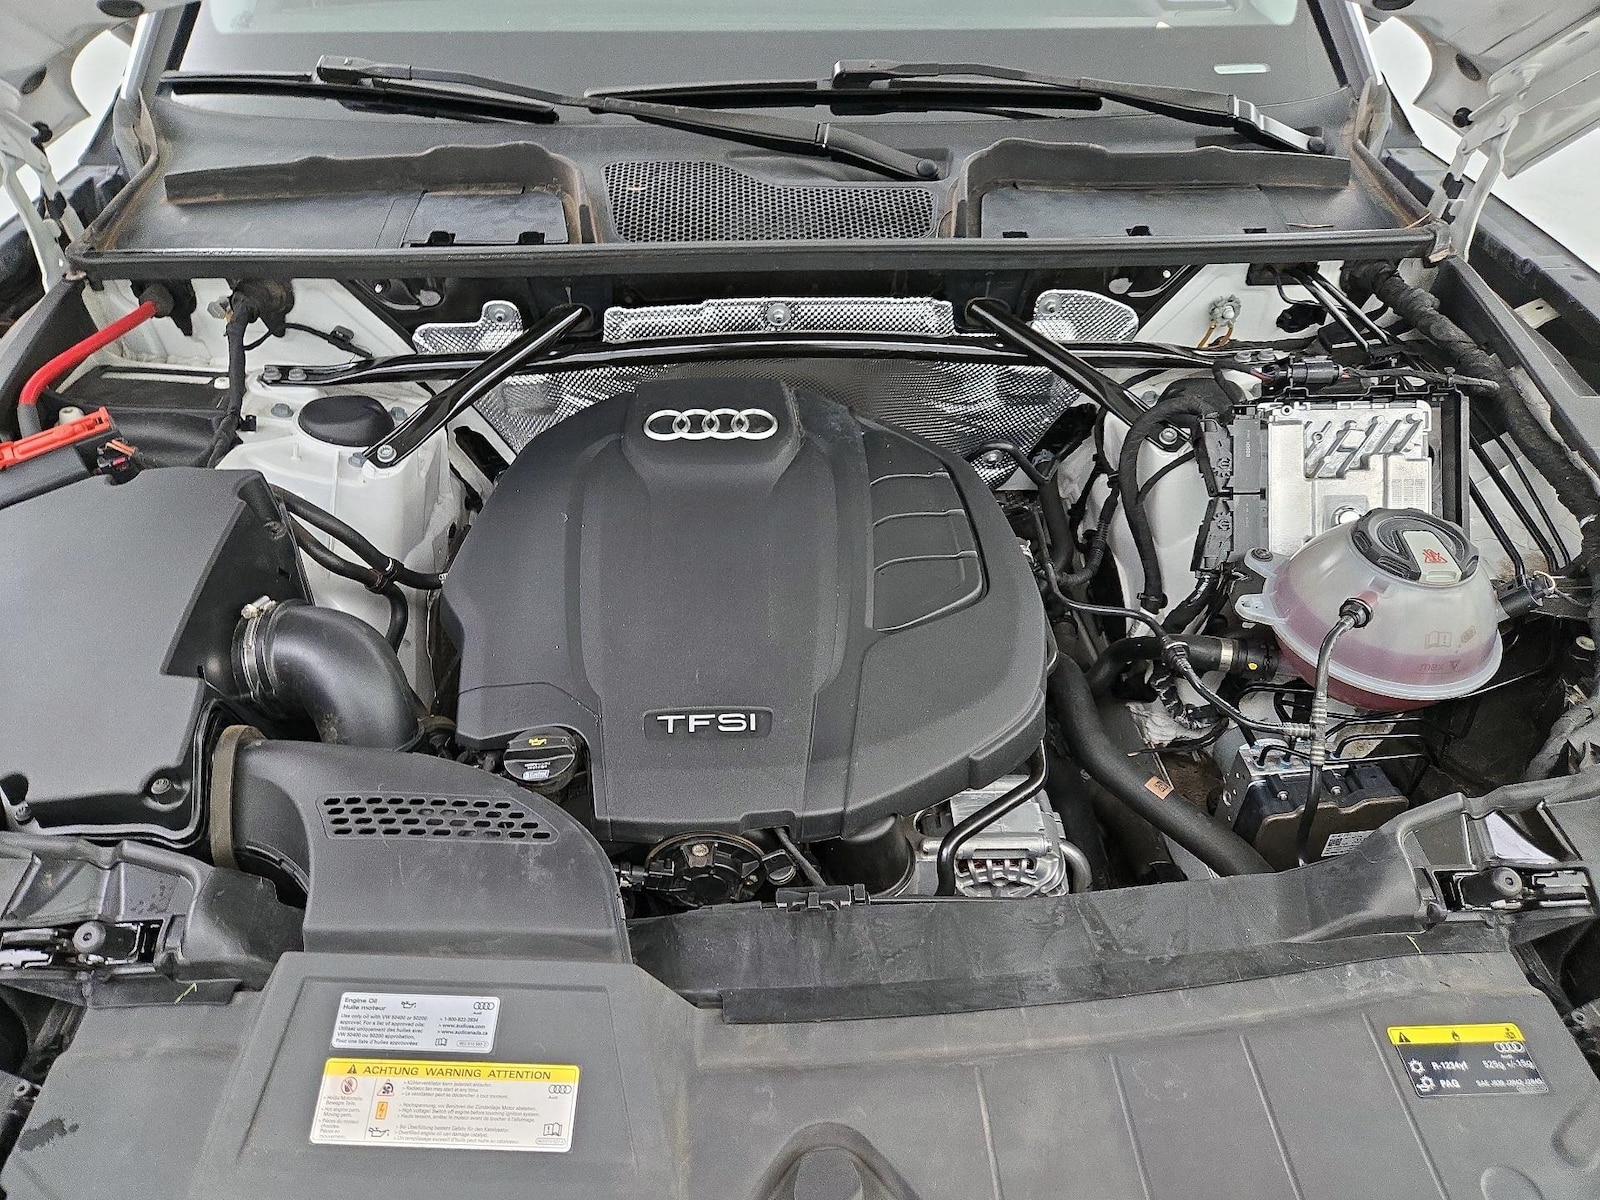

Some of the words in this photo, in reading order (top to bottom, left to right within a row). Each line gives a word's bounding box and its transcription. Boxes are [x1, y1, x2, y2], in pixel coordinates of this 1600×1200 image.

[1419, 662, 1444, 672] max
[656, 713, 756, 733] TFSI
[363, 1065, 419, 1076] ACHTUNG
[425, 1067, 482, 1077] WARNING
[487, 1069, 552, 1080] ATTENTION
[1439, 1079, 1461, 1089] PAG
